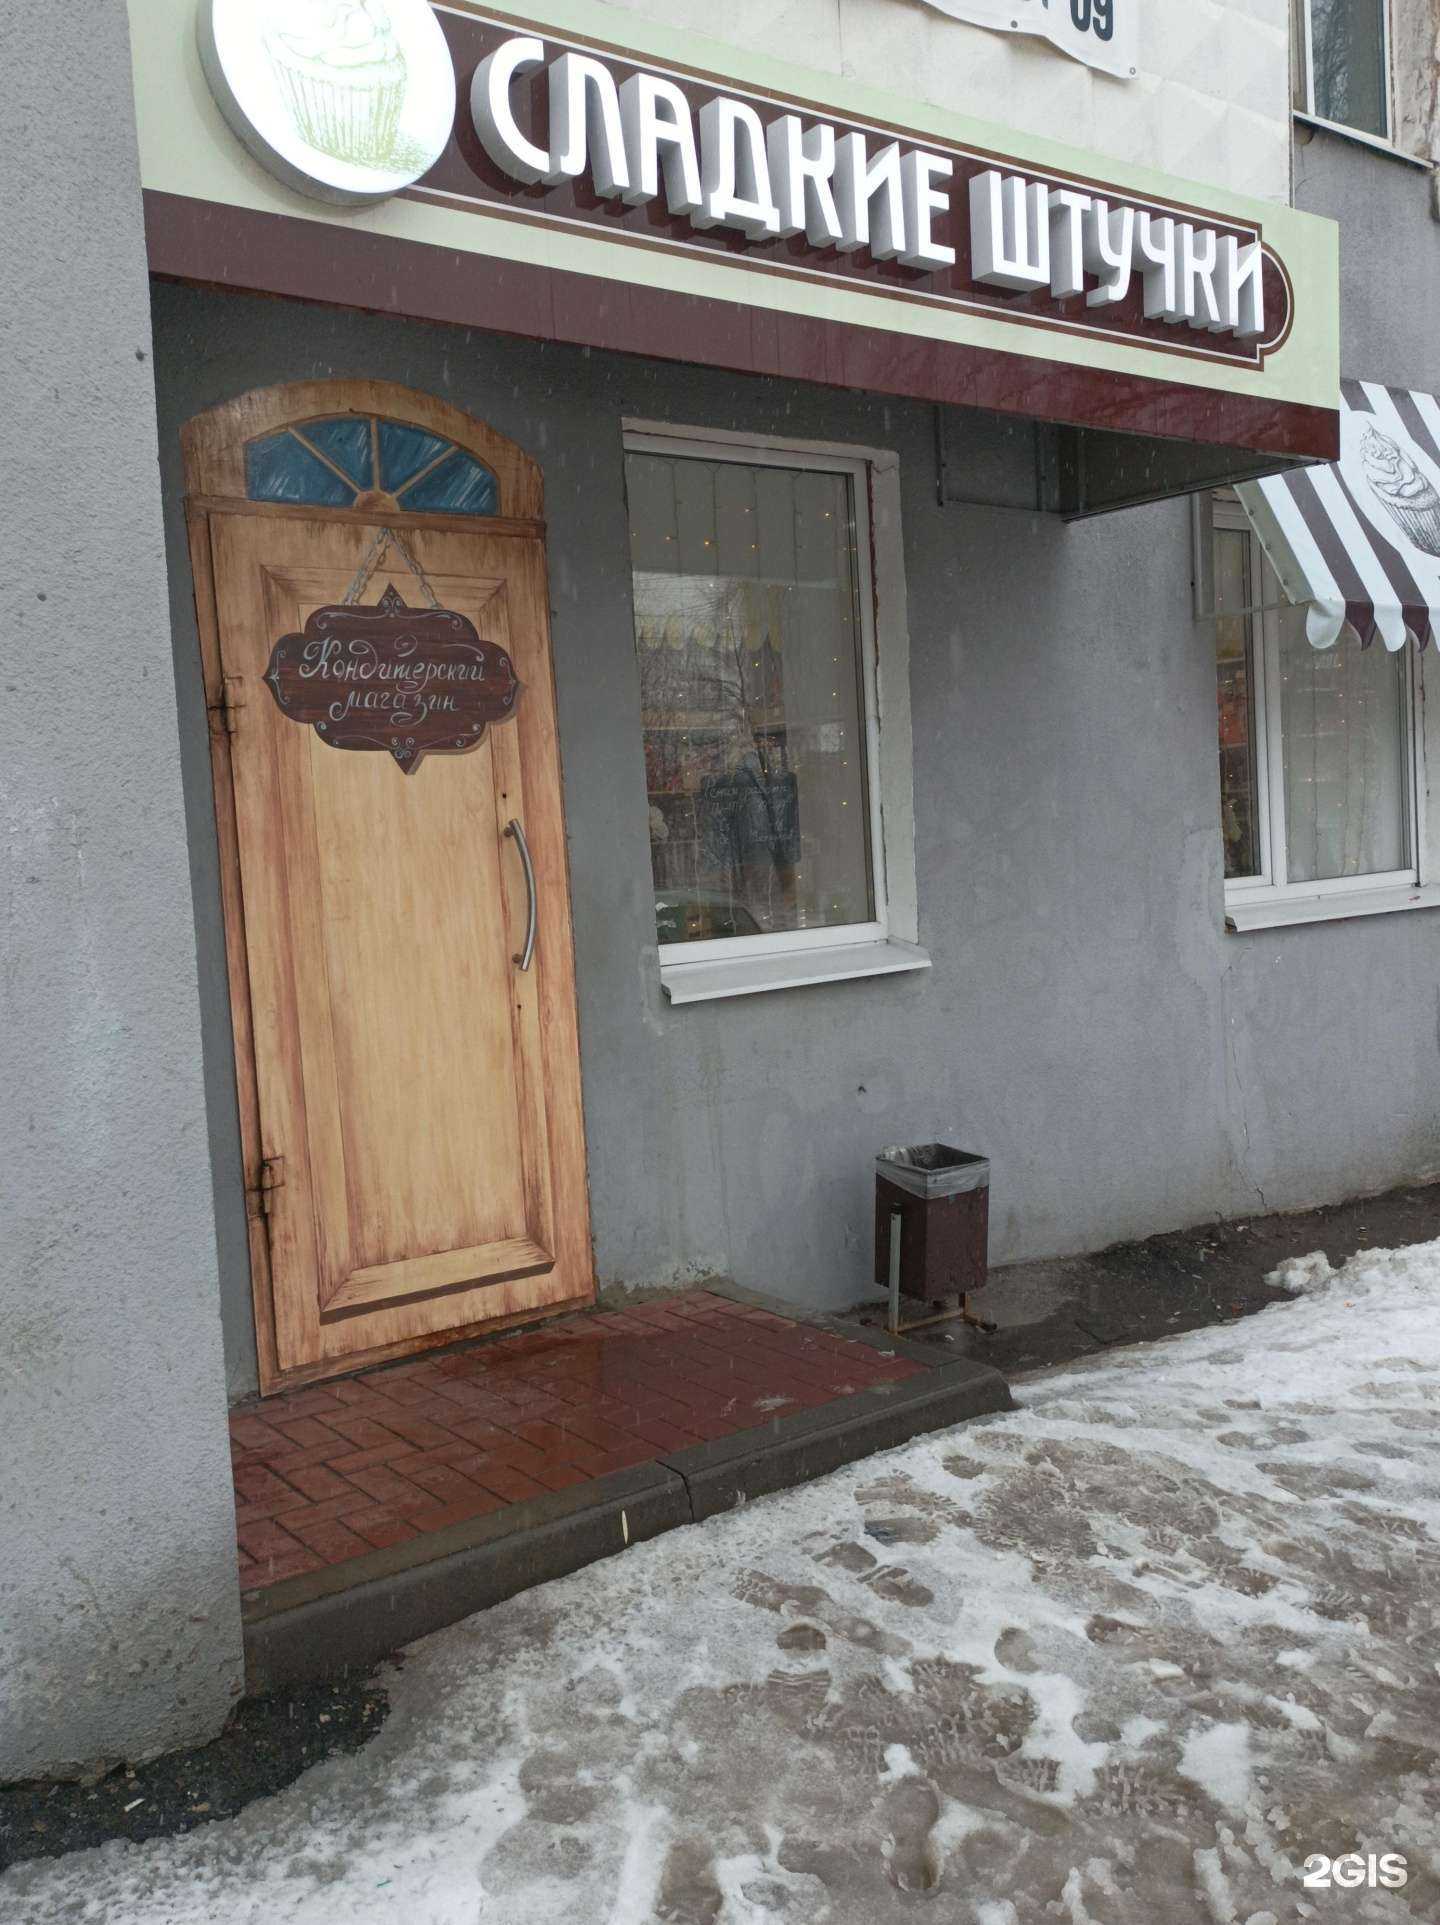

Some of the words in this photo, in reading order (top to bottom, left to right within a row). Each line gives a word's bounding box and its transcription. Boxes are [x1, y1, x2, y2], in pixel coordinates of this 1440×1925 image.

[471, 37, 956, 272] СЛАДКИЕ
[968, 169, 1264, 338] ШТУЧКИ
[299, 633, 486, 694] Кондитерский
[328, 688, 459, 727] магазин
